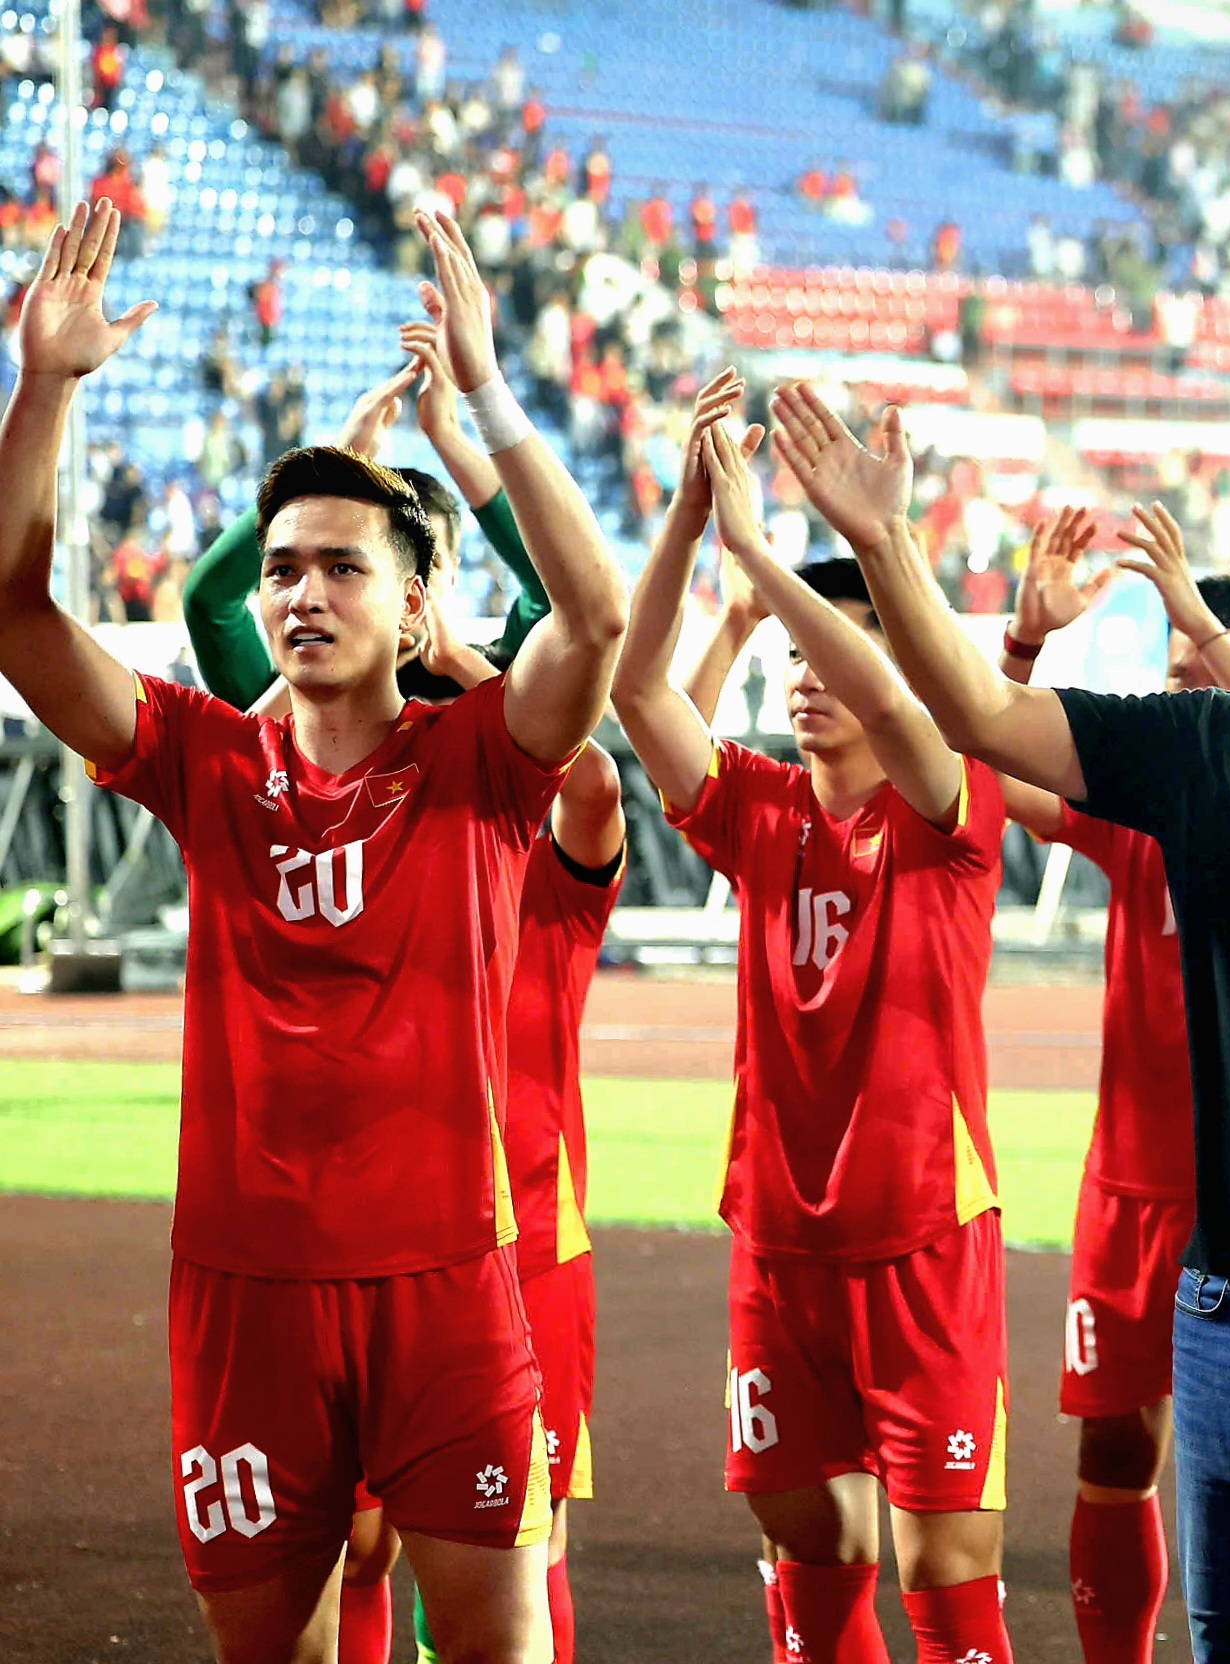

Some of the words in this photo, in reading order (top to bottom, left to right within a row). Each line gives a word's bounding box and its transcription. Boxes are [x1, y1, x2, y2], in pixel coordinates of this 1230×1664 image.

[270, 840, 363, 927] 20
[792, 888, 851, 970] 16
[731, 1367, 779, 1454] 16
[181, 1442, 277, 1544] 20
